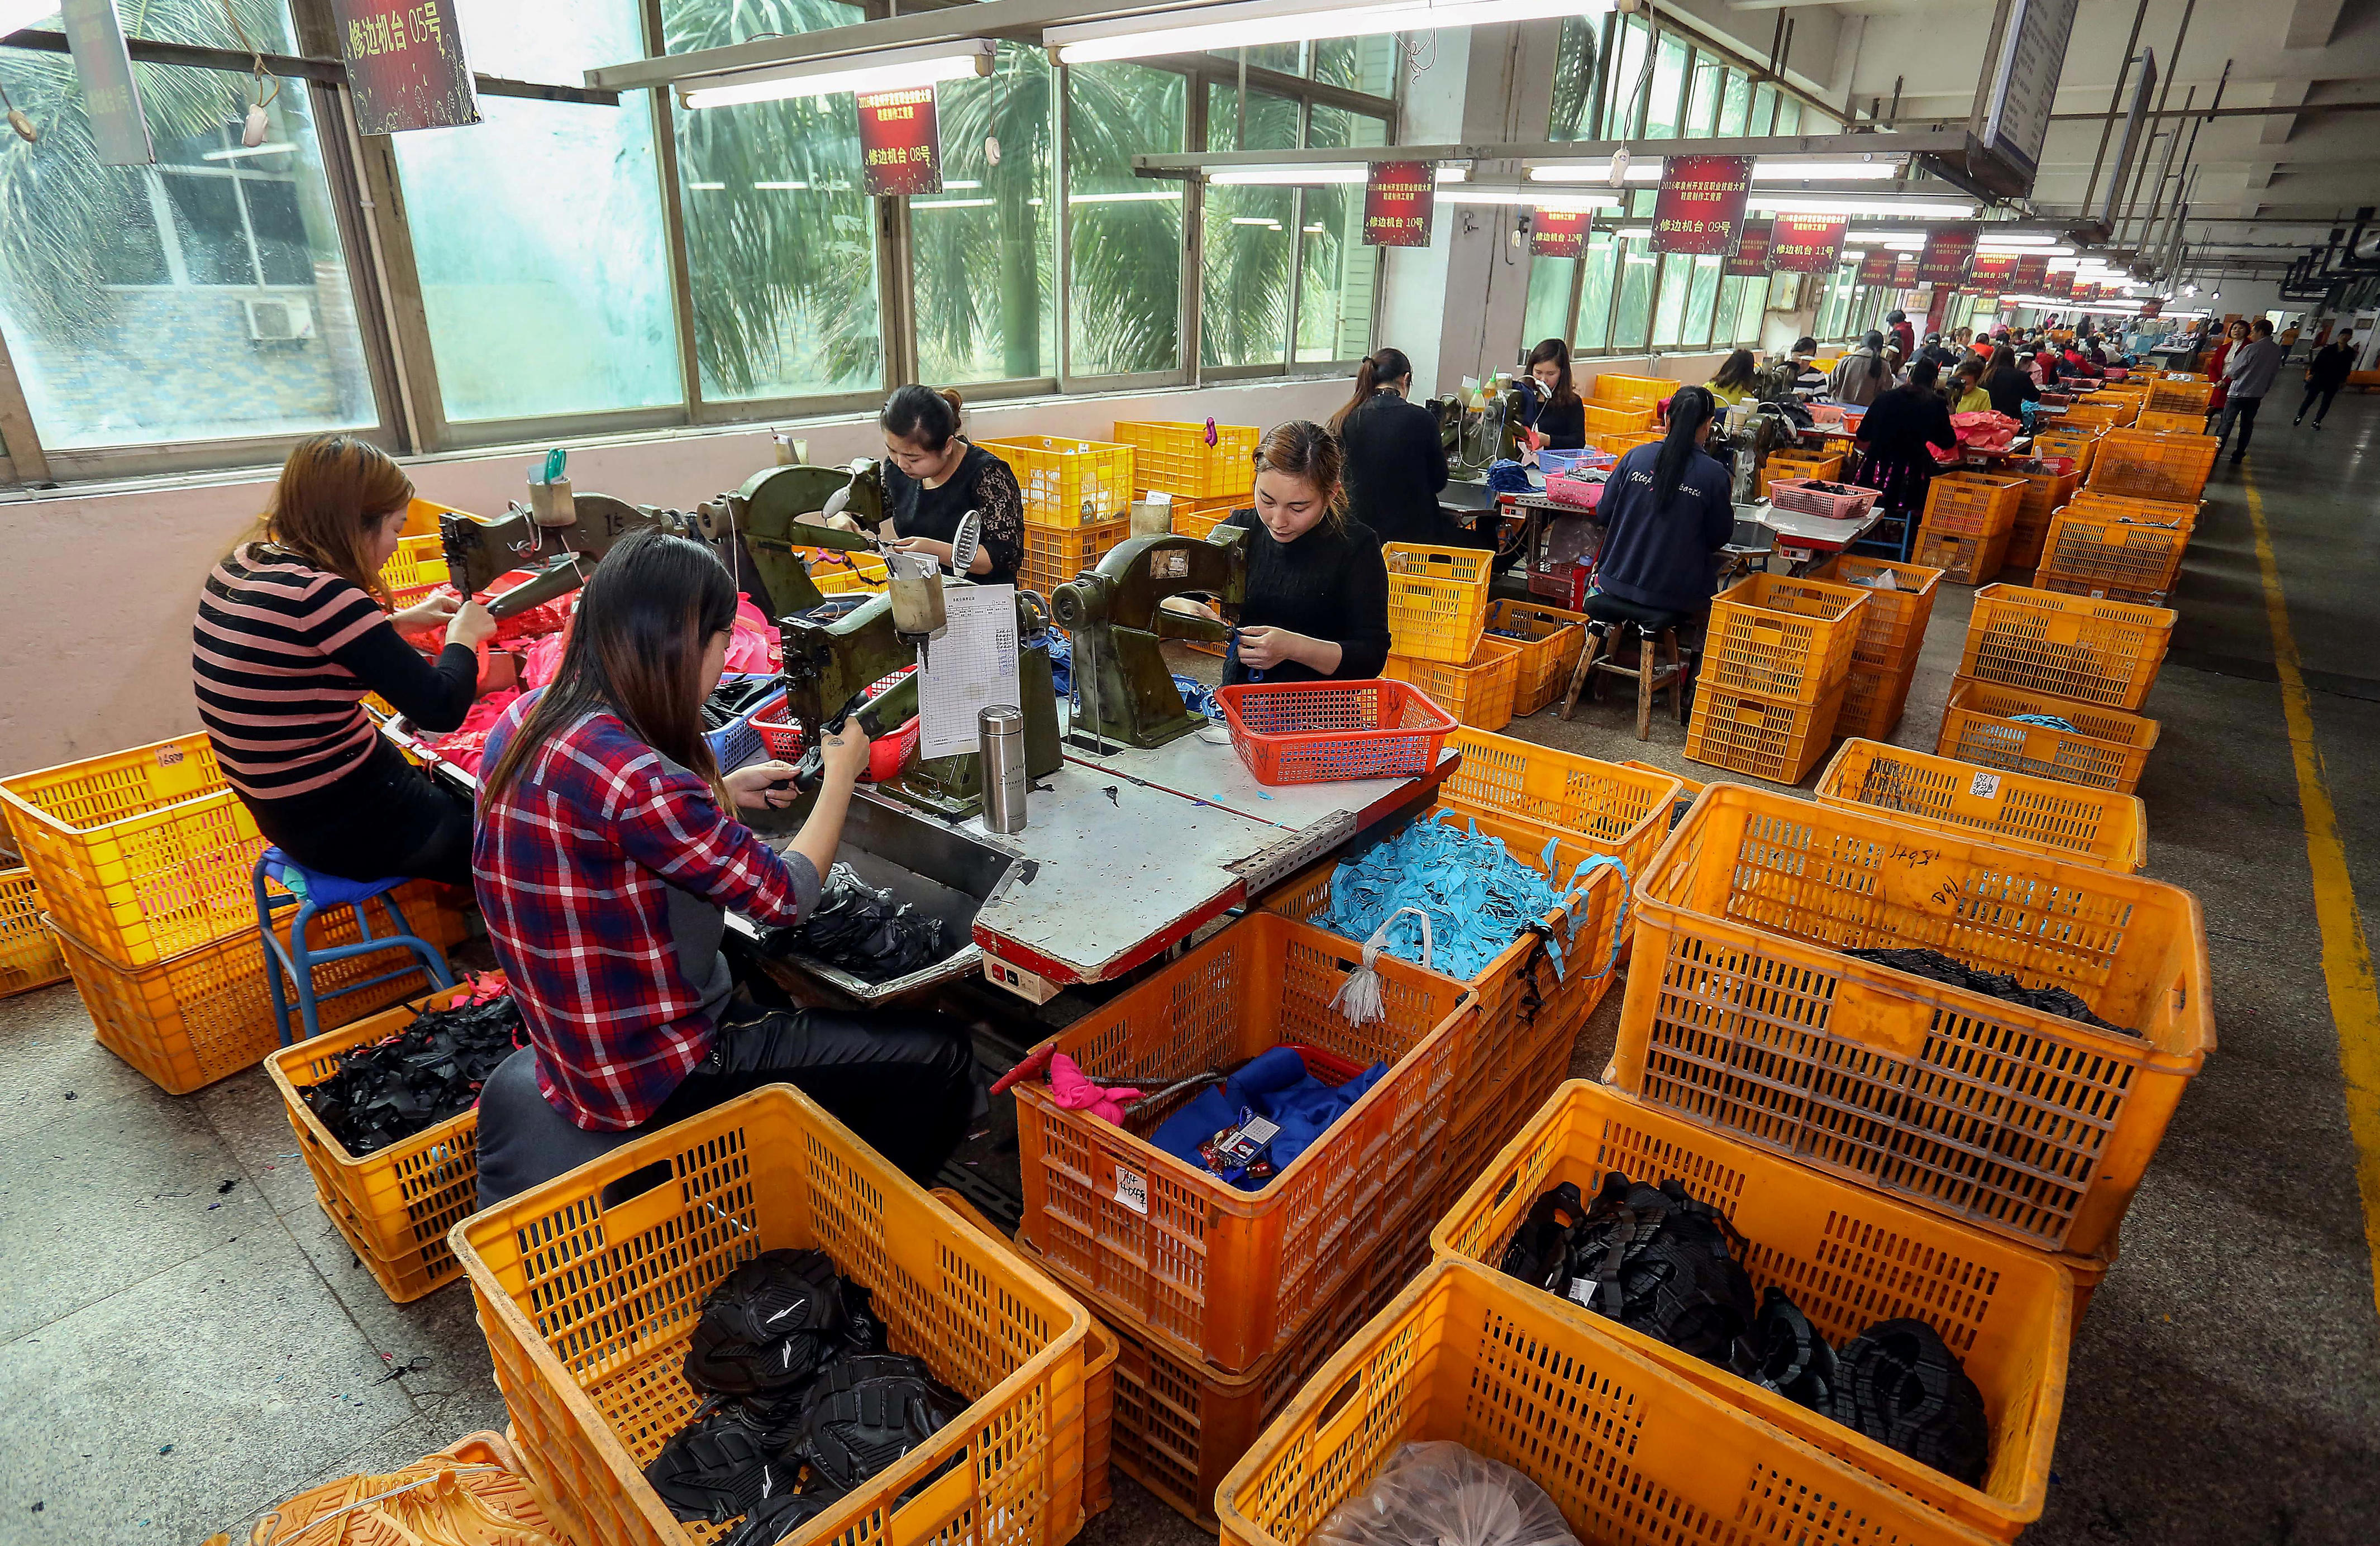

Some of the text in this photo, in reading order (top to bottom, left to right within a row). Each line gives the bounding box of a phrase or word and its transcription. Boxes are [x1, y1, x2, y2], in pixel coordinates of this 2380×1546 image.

[349, 1, 441, 59] 修边机台 05号
[868, 145, 931, 166] 修边机台 08号
[1370, 216, 1424, 229] 修边机台 10号
[1659, 218, 1732, 234] 修边机台 09号
[1535, 232, 1565, 242] 修边机台
[1776, 244, 1834, 256] 修边机台 11号
